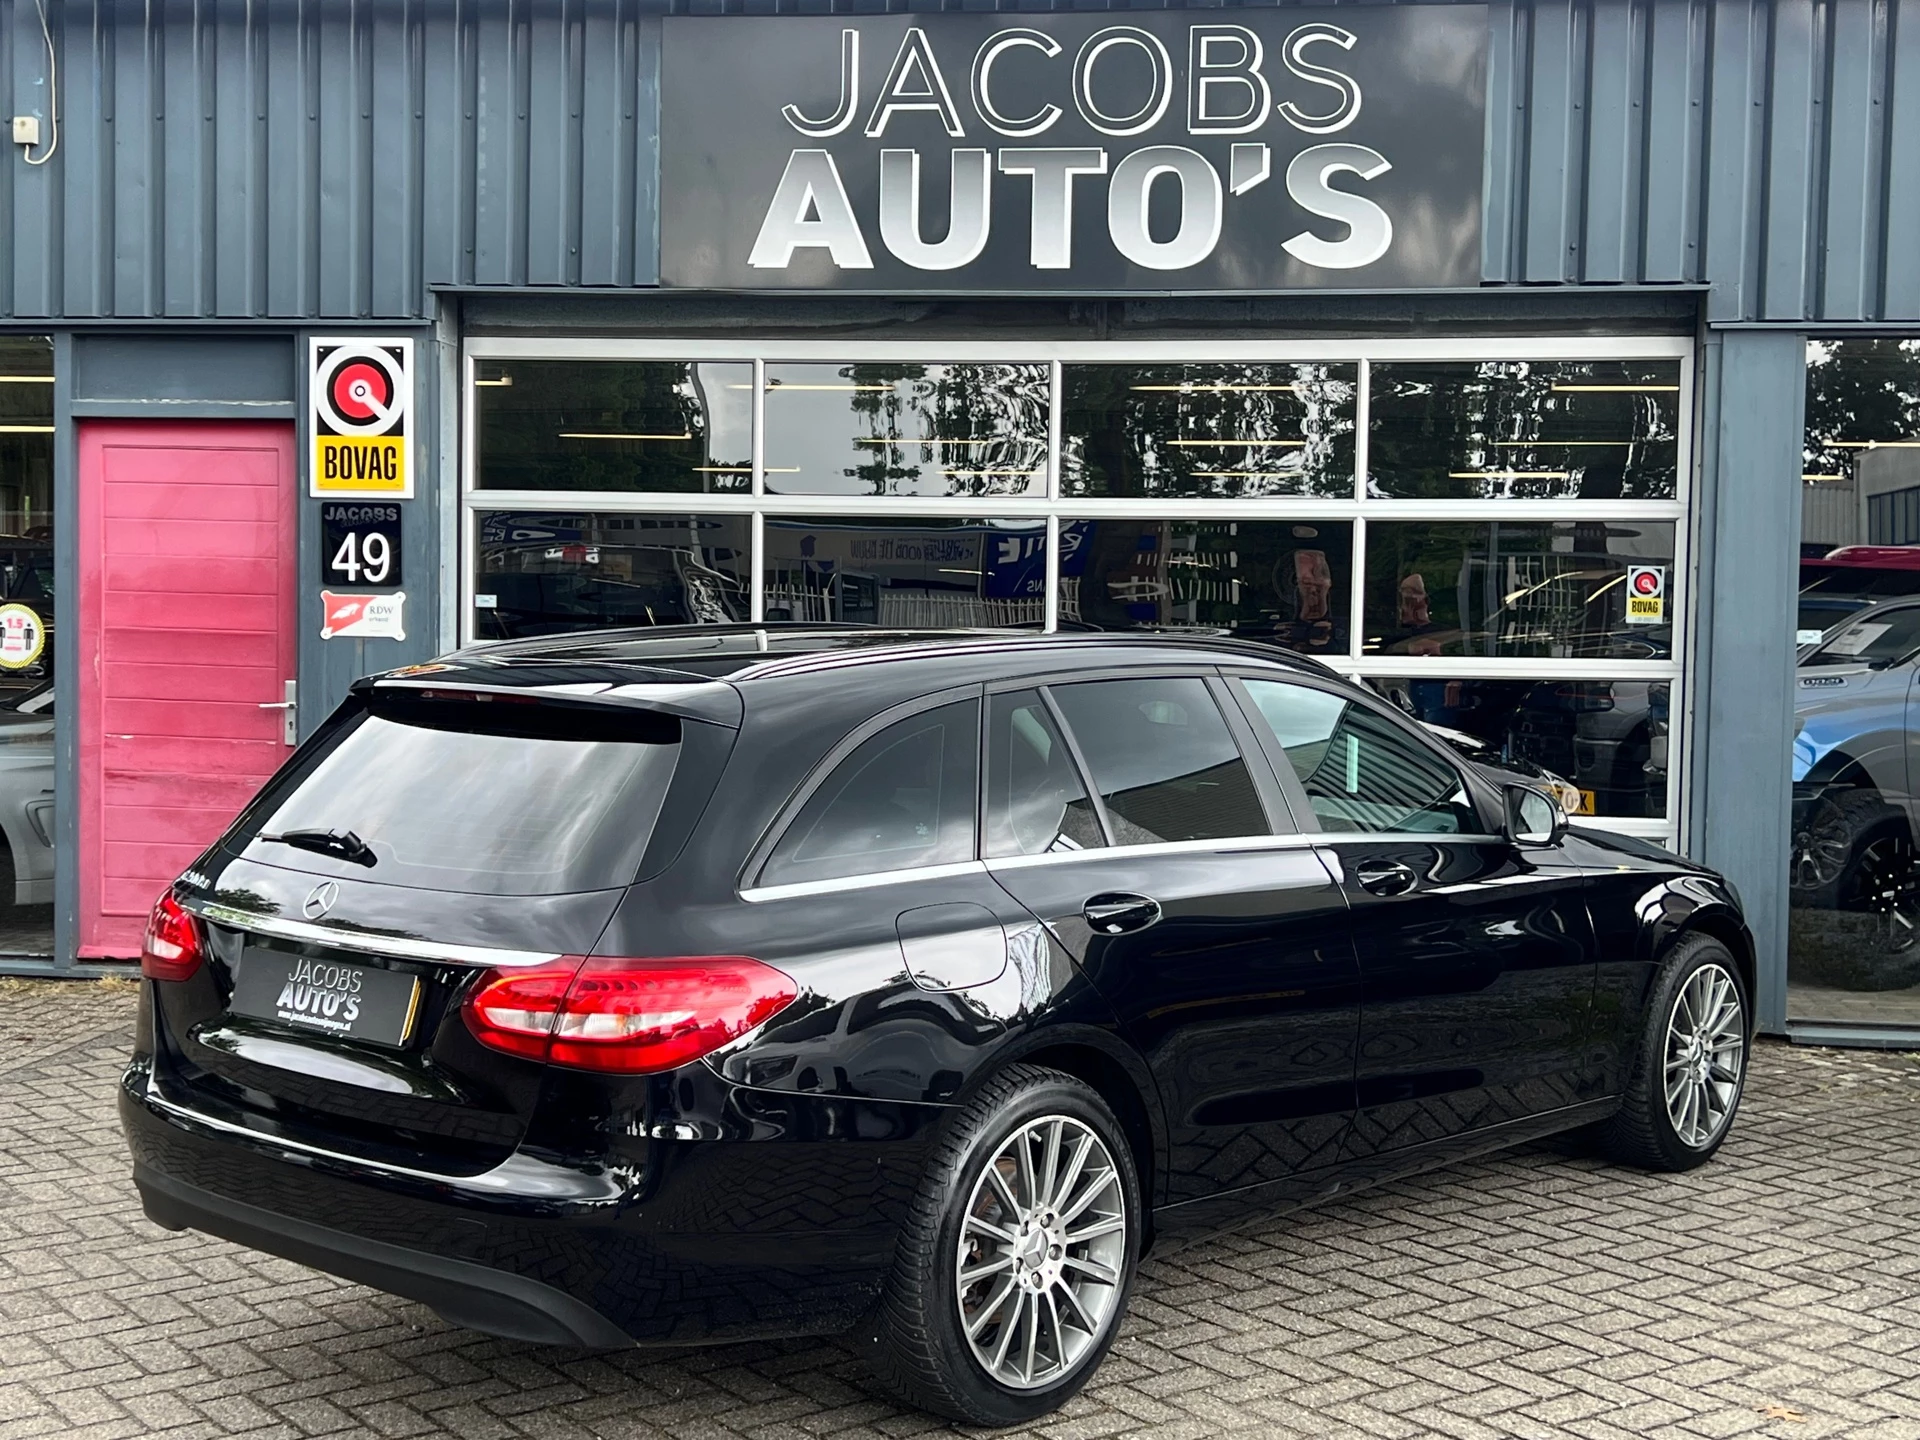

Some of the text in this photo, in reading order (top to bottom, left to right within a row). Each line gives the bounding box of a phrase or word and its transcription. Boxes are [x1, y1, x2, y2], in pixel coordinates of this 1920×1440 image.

[781, 23, 1362, 137] JACOBS
[747, 143, 1393, 270] AUTO'S
[325, 446, 397, 480] BOVAG
[324, 507, 398, 521] JACOBS
[331, 532, 390, 582] 49
[6, 618, 23, 629] 1.5
[369, 605, 394, 615] RDW
[1631, 601, 1659, 613] BOVAG
[288, 959, 363, 993] JACOBS
[276, 982, 361, 1021] AUTO'S
